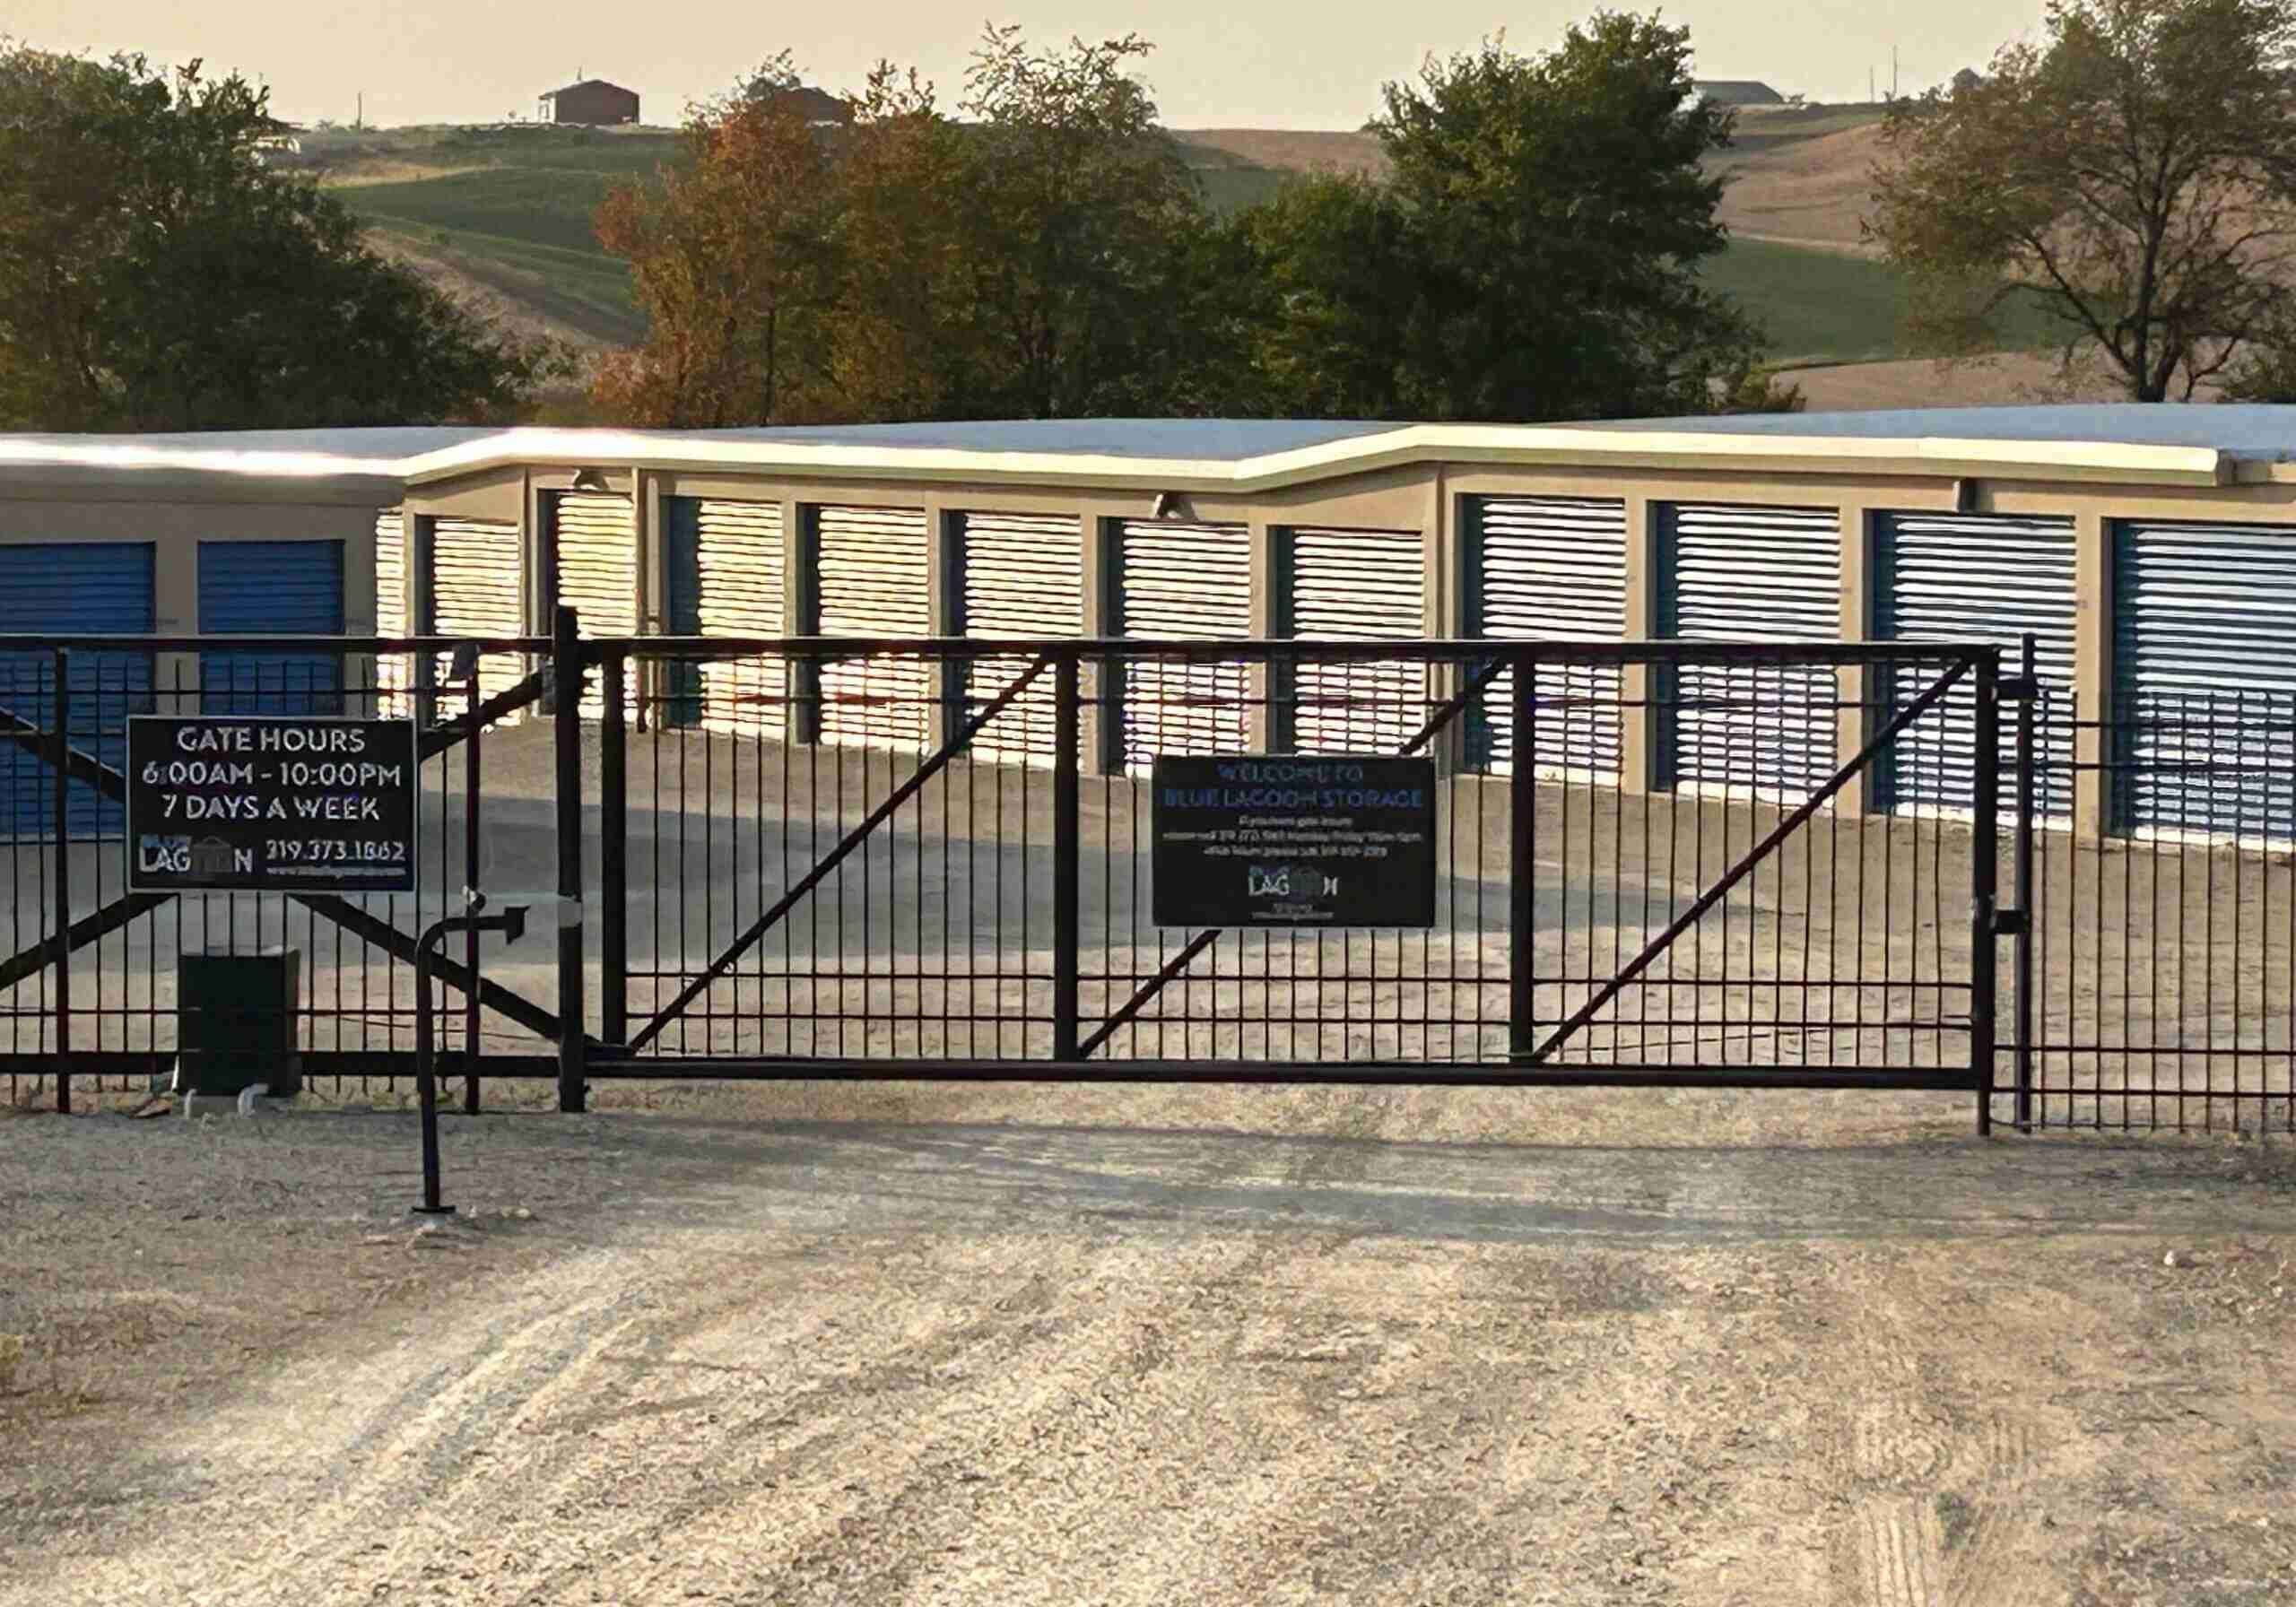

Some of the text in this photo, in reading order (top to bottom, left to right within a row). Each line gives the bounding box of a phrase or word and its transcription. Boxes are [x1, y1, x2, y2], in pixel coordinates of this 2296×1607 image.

[178, 726, 366, 752] GATE HOURS
[142, 760, 253, 786] 6:00AM
[280, 762, 402, 786] 10:00PM
[161, 795, 381, 820] 7 DAYS A WEEK
